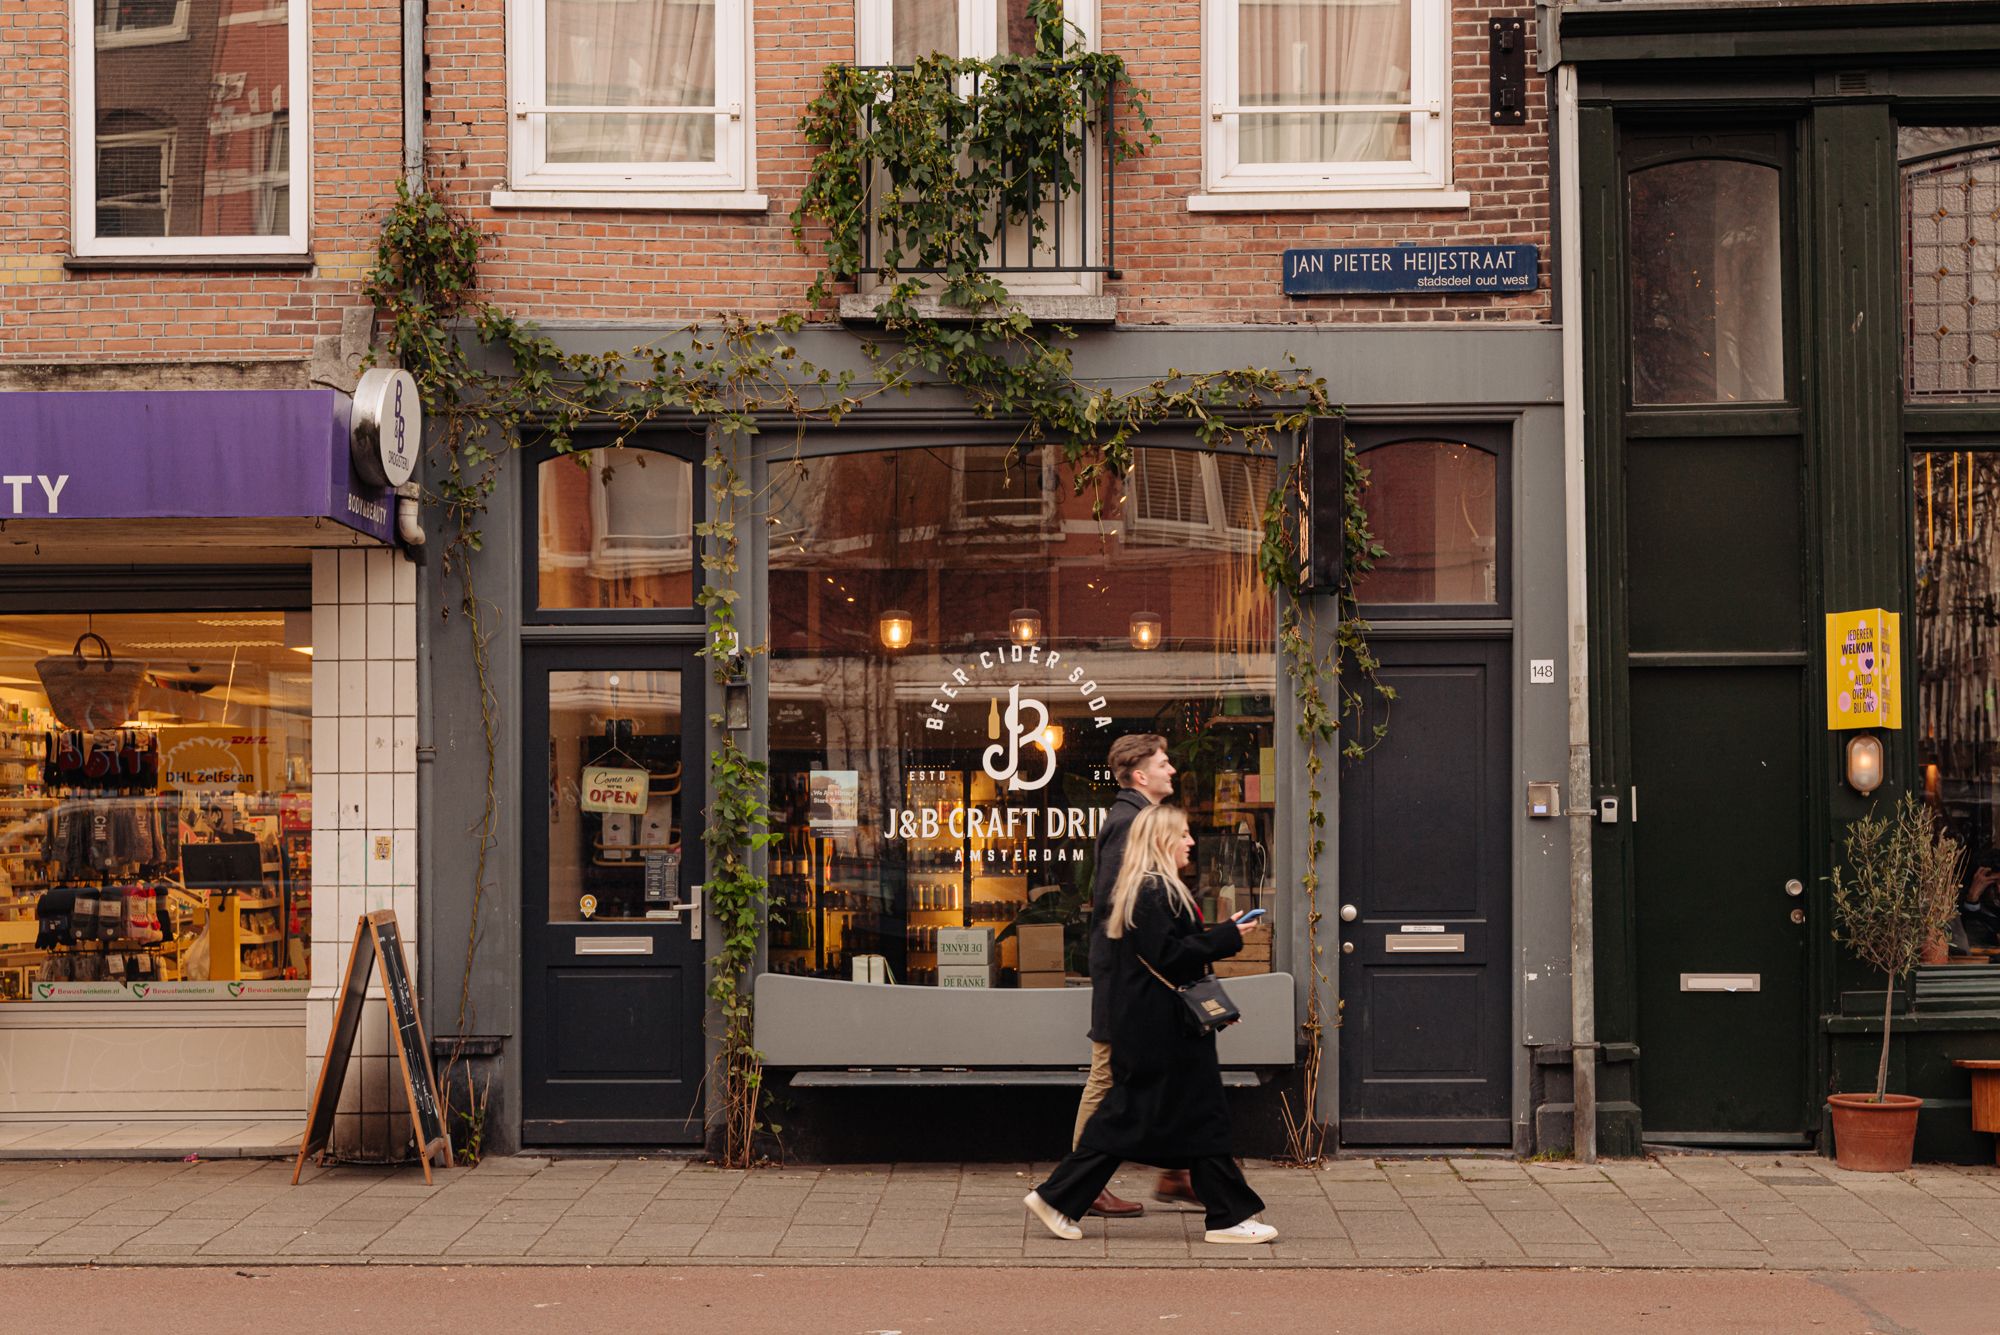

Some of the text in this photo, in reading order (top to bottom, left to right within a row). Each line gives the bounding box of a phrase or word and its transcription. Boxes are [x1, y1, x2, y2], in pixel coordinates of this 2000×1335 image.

[1292, 251, 1516, 279] JAN PIETER HEIJESTRAAT
[1417, 274, 1529, 287] stadsdeel oud west
[2, 474, 70, 514] TY
[1847, 627, 1874, 641] IEDEREEN
[1841, 641, 1874, 655] WELKOM
[1532, 665, 1553, 678] 148
[925, 644, 1113, 731] BEER CIDER SODA
[1863, 700, 1875, 713] ONS
[231, 736, 268, 745] DHL
[166, 770, 254, 783] DHL Zelfscan
[594, 771, 635, 785] Come in
[909, 771, 947, 781] ESTD
[1094, 770, 1117, 780] 20
[589, 789, 639, 805] OPEN
[94, 815, 107, 841] Chill
[883, 808, 942, 840] J&B
[948, 807, 1041, 840] CRAFT
[954, 848, 1085, 862] AMSTERDAM
[940, 943, 983, 953] DE RANKE
[943, 978, 986, 988] DE RANKE
